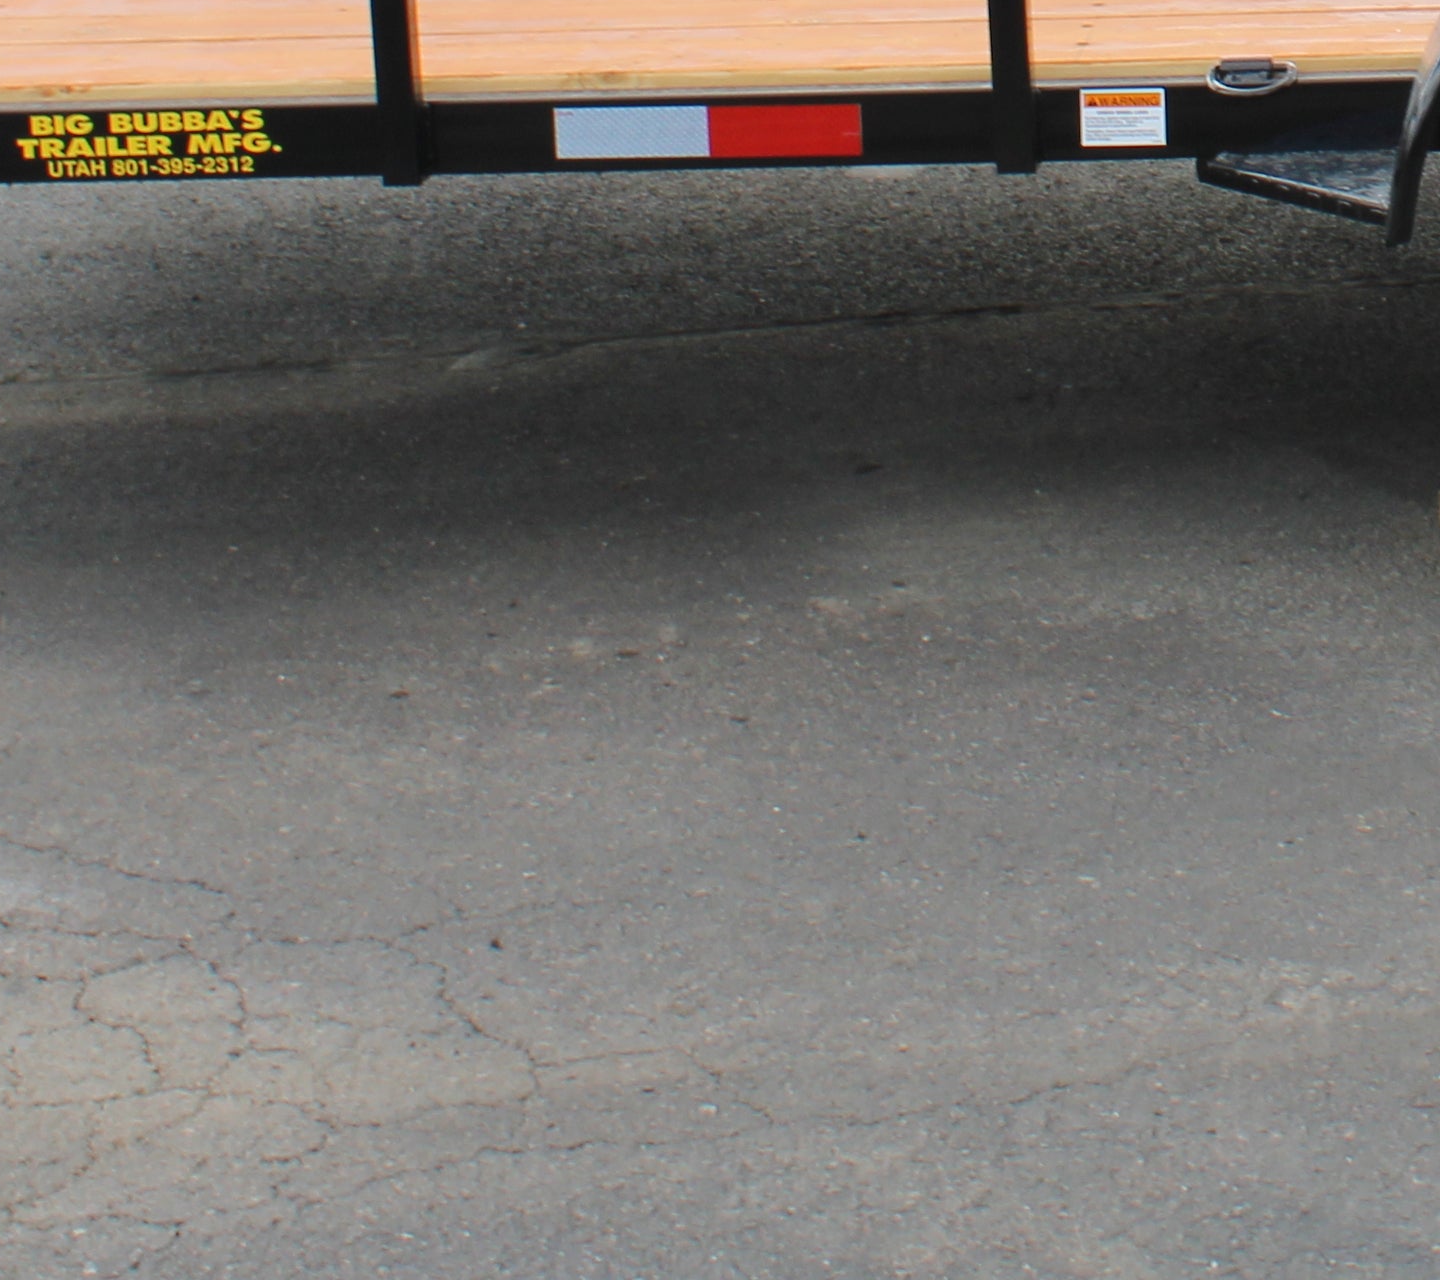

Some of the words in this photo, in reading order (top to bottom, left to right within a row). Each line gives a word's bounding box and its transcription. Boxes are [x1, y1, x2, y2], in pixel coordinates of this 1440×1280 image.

[1100, 93, 1160, 106] WARNING
[30, 114, 94, 136] BIG
[108, 109, 265, 135] BUBBA'S
[17, 135, 173, 159] TRAILER
[187, 132, 282, 155] MFG.
[48, 159, 107, 178] UTAH
[112, 156, 255, 177] 801-395-2312
